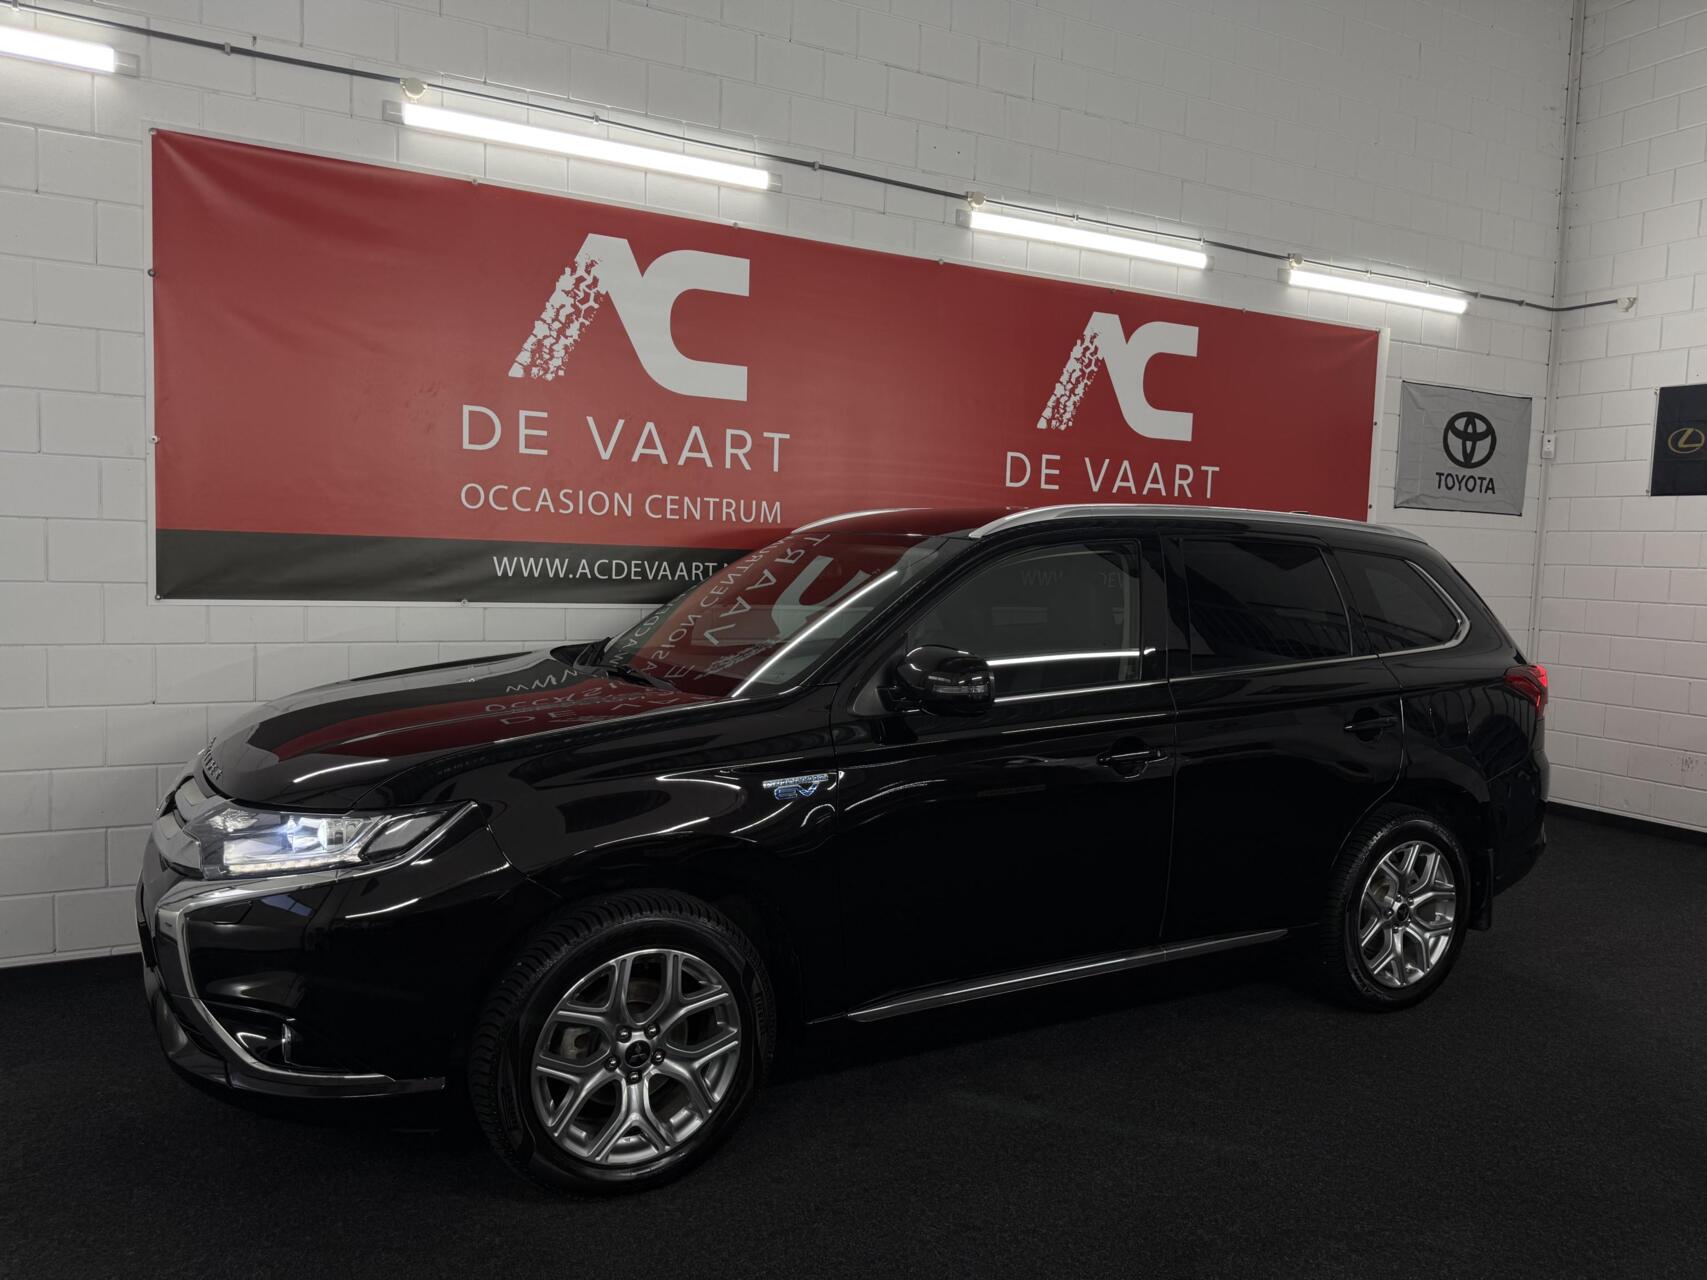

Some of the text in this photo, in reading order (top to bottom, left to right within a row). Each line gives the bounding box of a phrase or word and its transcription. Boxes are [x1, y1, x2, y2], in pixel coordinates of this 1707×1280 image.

[462, 404, 791, 473] DE VAART
[1005, 451, 1220, 499] DE VAART
[1435, 471, 1496, 495] TOYOTA
[460, 483, 782, 524] OCCASION CENTRUM
[492, 555, 728, 582] WWW.ACDEVAART
